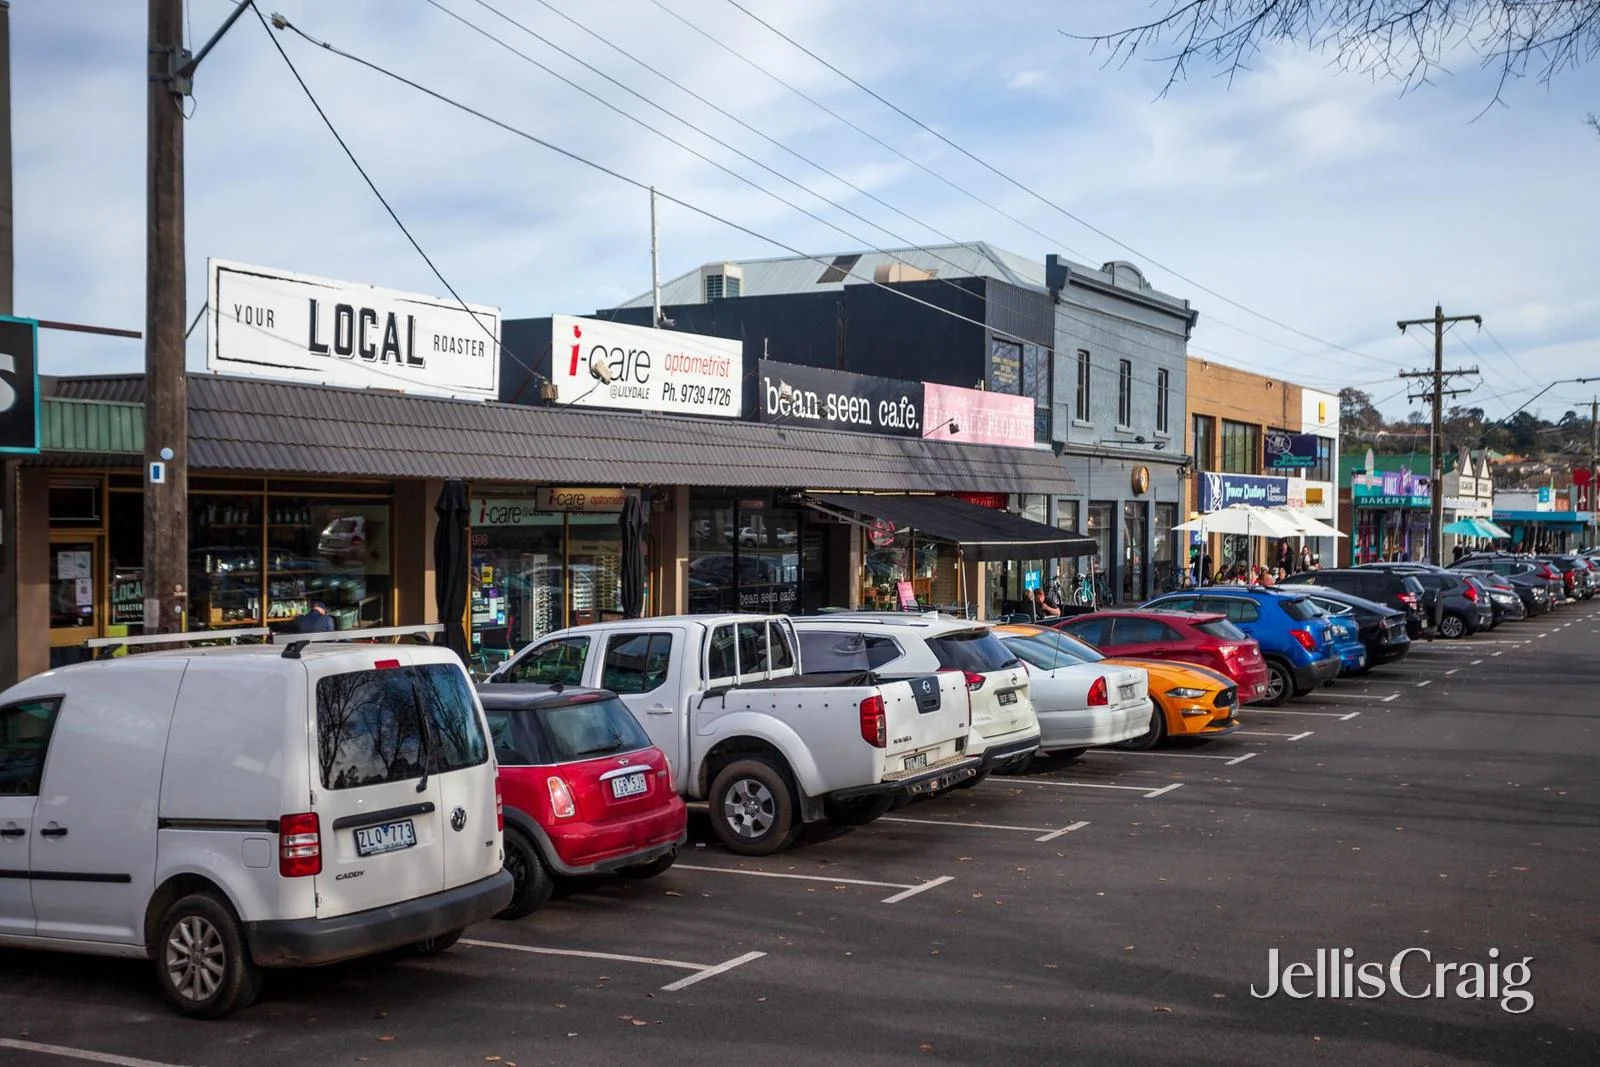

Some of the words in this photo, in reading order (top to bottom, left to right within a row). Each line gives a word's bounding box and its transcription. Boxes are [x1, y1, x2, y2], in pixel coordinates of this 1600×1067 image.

[234, 303, 275, 329] YOUR
[308, 298, 427, 369] LOCAL
[433, 334, 486, 358] ROASTER
[569, 325, 651, 384] i-care
[665, 351, 732, 378] optometrist
[610, 385, 651, 400] @LILYDALE
[662, 382, 678, 402] Ph.
[681, 383, 705, 405] 9739
[707, 386, 732, 407] 4726
[764, 376, 820, 420] bean
[827, 393, 872, 425] seen
[878, 395, 920, 430] cafe.
[548, 489, 586, 506] i-care
[1360, 496, 1407, 505] BAKERY
[479, 498, 522, 524] i-care
[111, 581, 144, 603] LOCA
[358, 828, 383, 848] ZLQ
[389, 822, 413, 843] 773
[335, 870, 365, 881] CADDY
